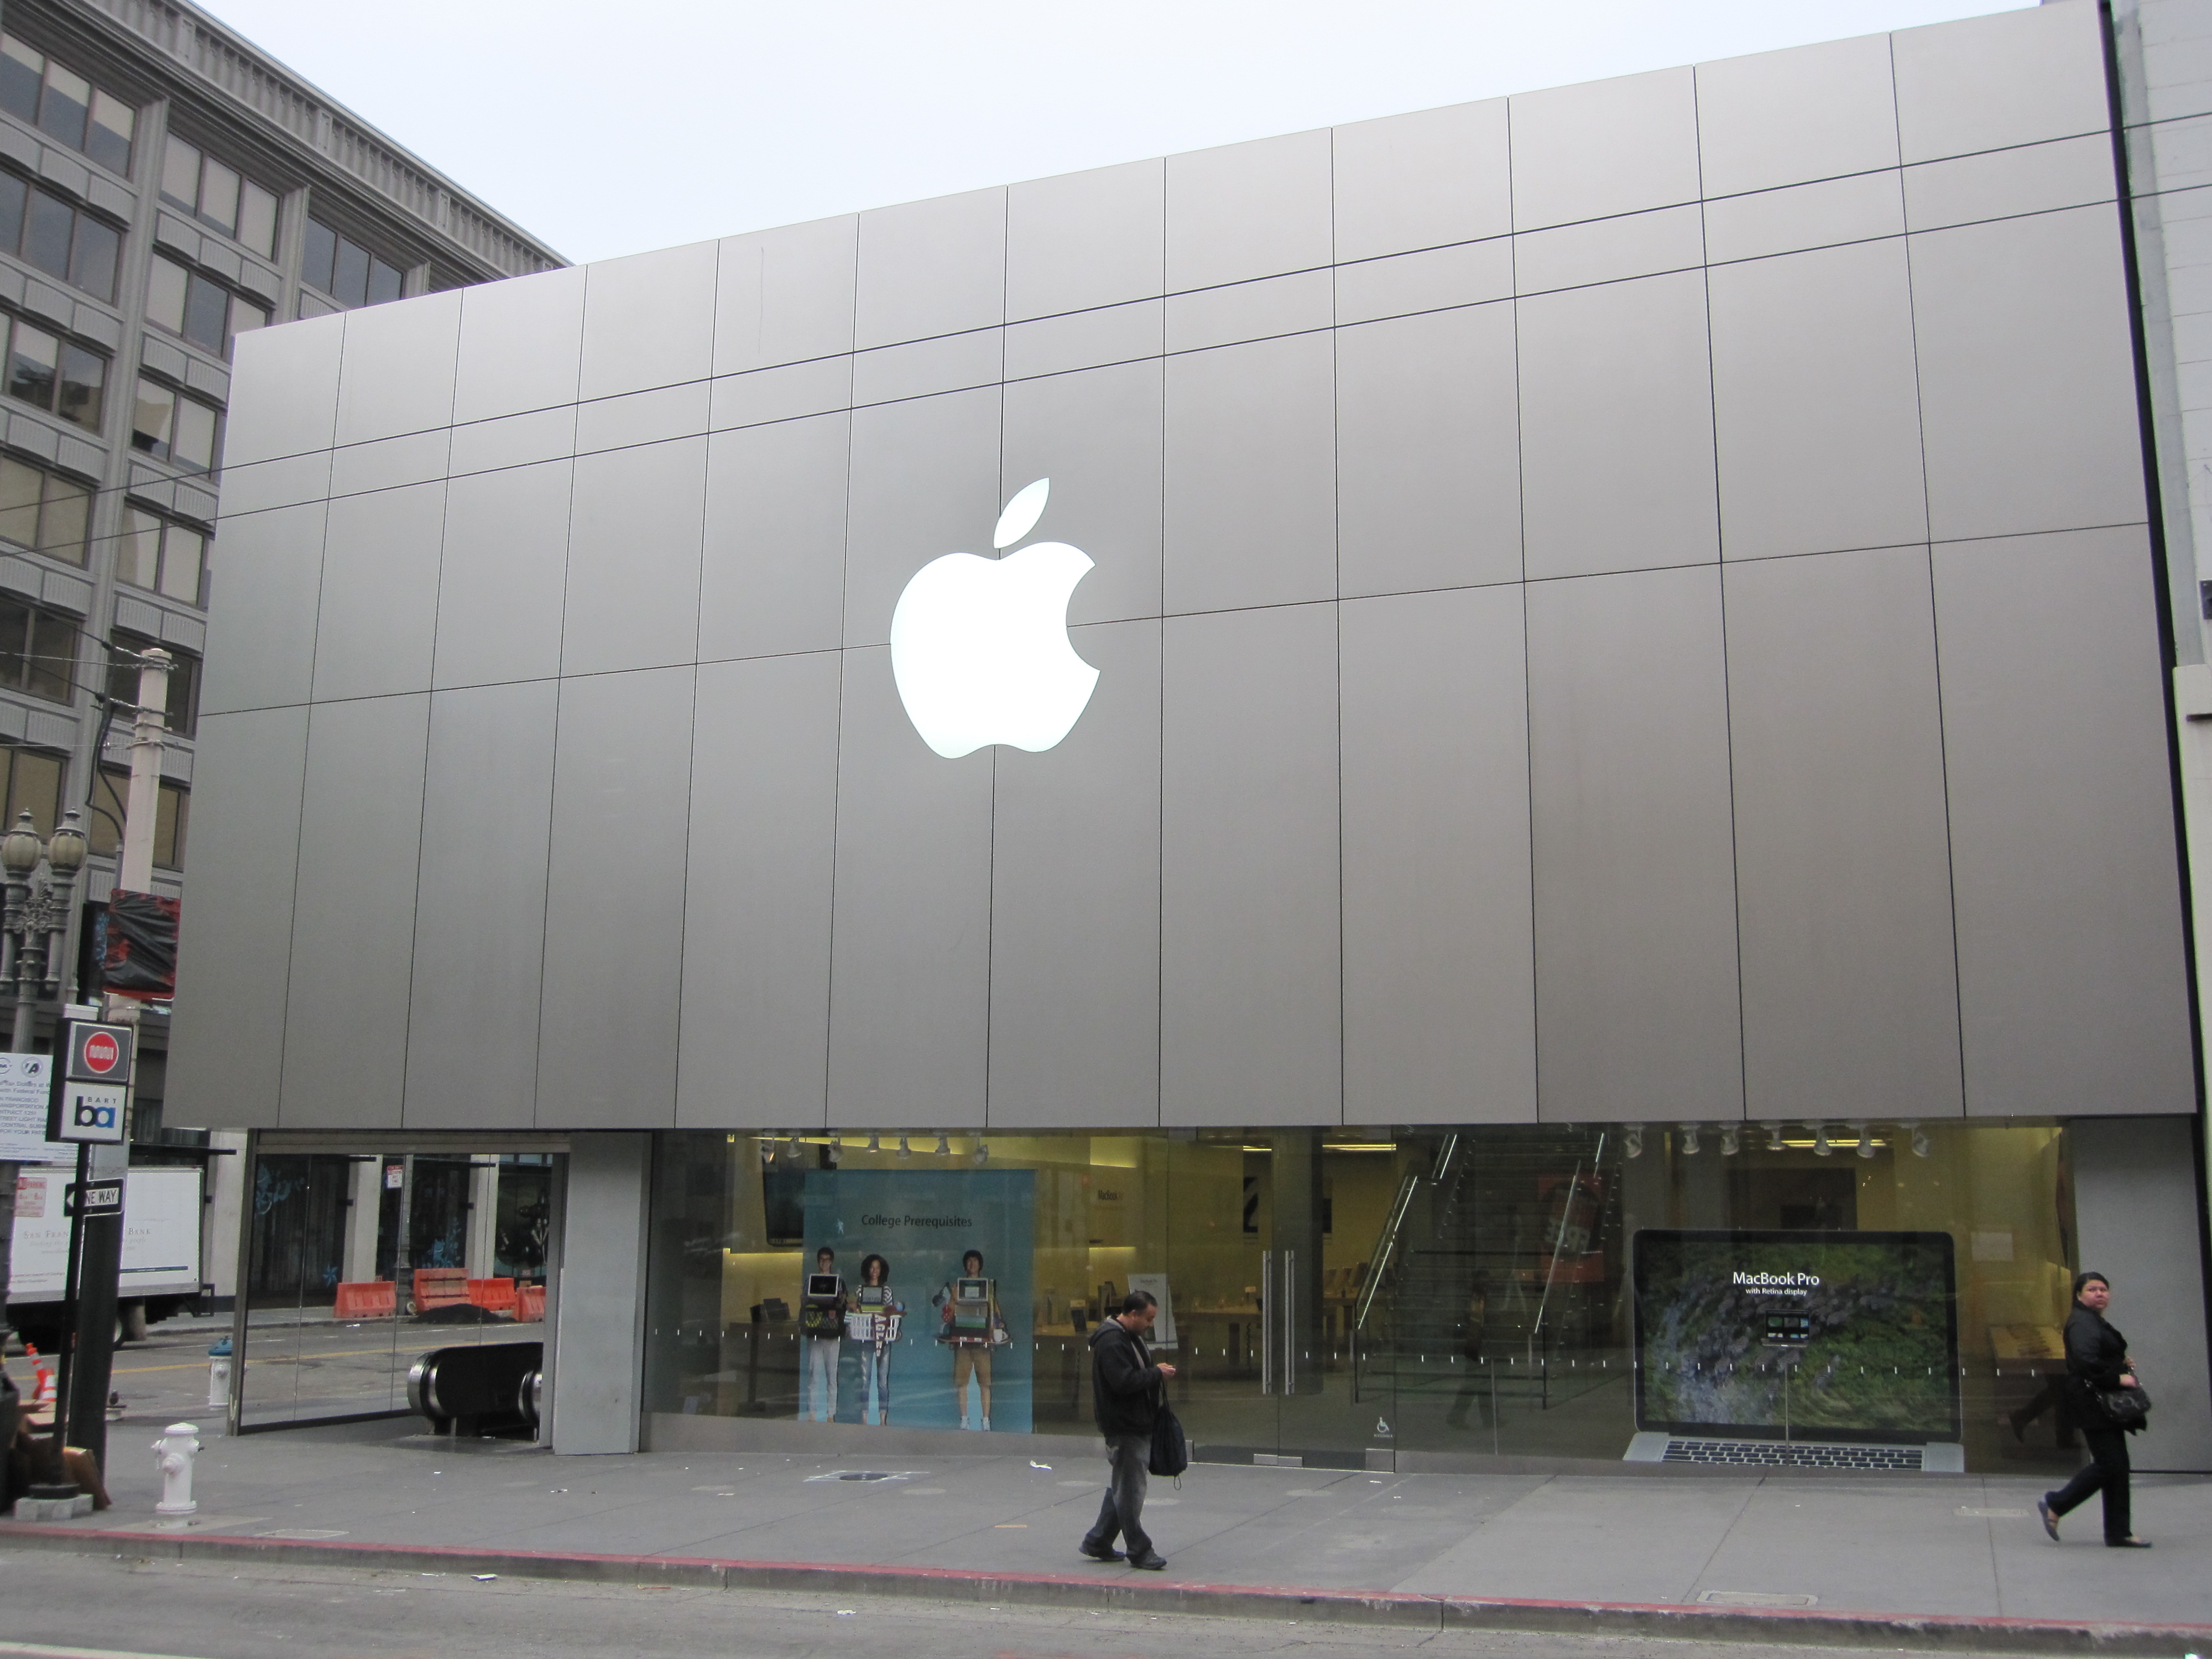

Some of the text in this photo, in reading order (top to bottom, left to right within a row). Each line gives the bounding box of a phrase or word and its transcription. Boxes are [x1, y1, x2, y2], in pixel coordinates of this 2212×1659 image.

[86, 1190, 117, 1204] NE WAY
[862, 1214, 972, 1229] College Prerequisites
[1733, 1271, 1820, 1286] MacBook Pro
